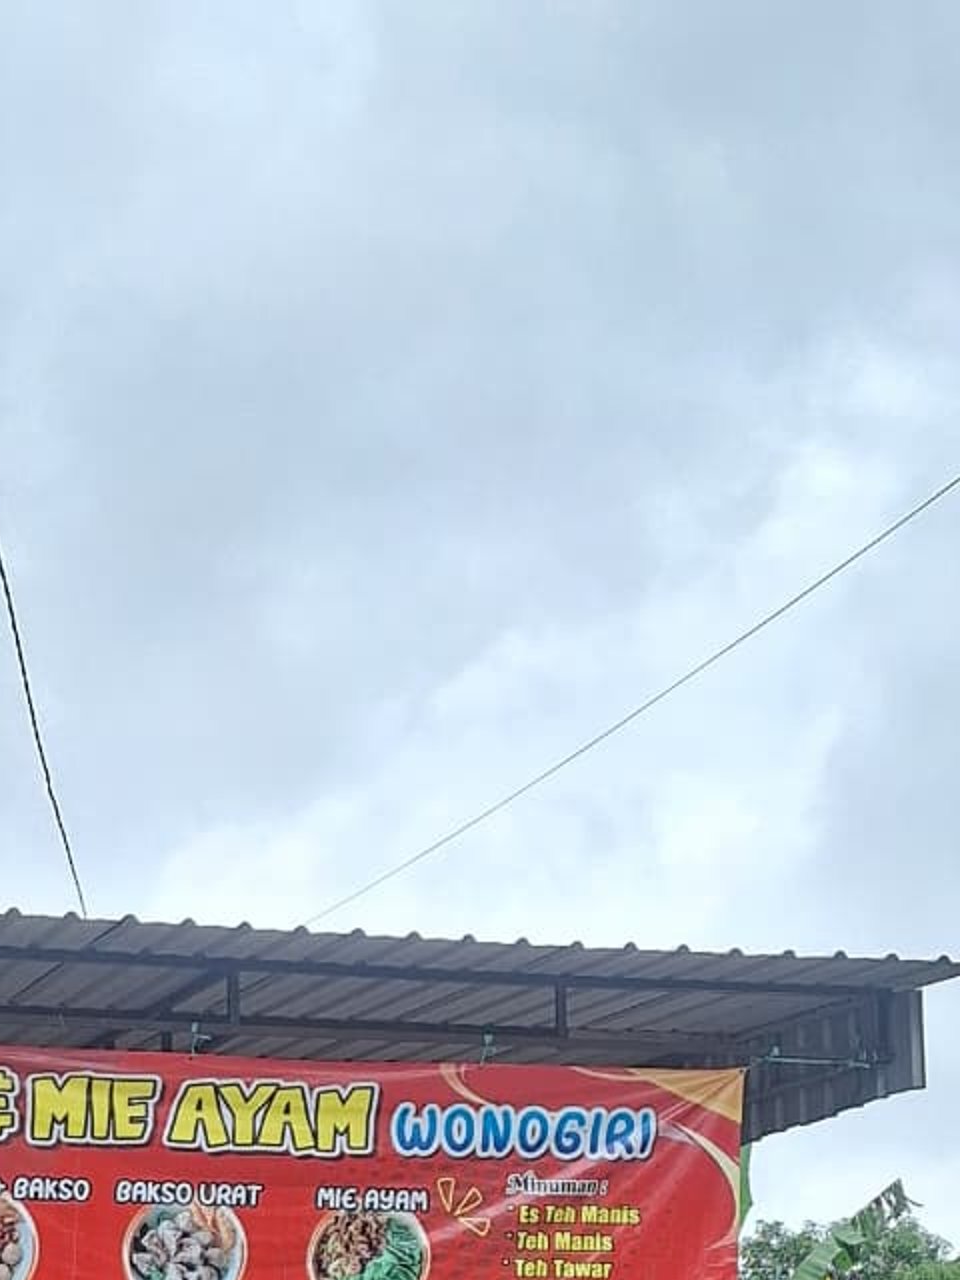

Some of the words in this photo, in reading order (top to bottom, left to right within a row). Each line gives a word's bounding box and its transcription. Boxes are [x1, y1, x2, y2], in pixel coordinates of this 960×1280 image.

[28, 1073, 159, 1146] MIE
[165, 1080, 379, 1155] AYAM
[392, 1103, 656, 1159] WONOGIRI
[13, 1180, 90, 1201] BAKSO
[115, 1181, 194, 1204] BAKSO
[199, 1184, 262, 1206] URAT
[317, 1187, 357, 1210] MIE
[364, 1188, 428, 1212] AYAM
[520, 1206, 539, 1224] Es
[545, 1205, 575, 1224] Teh
[581, 1205, 641, 1225] Manis
[517, 1232, 549, 1251] Teh
[554, 1232, 614, 1252] Manis
[515, 1259, 548, 1277] Teh
[554, 1260, 613, 1279] Tawar
